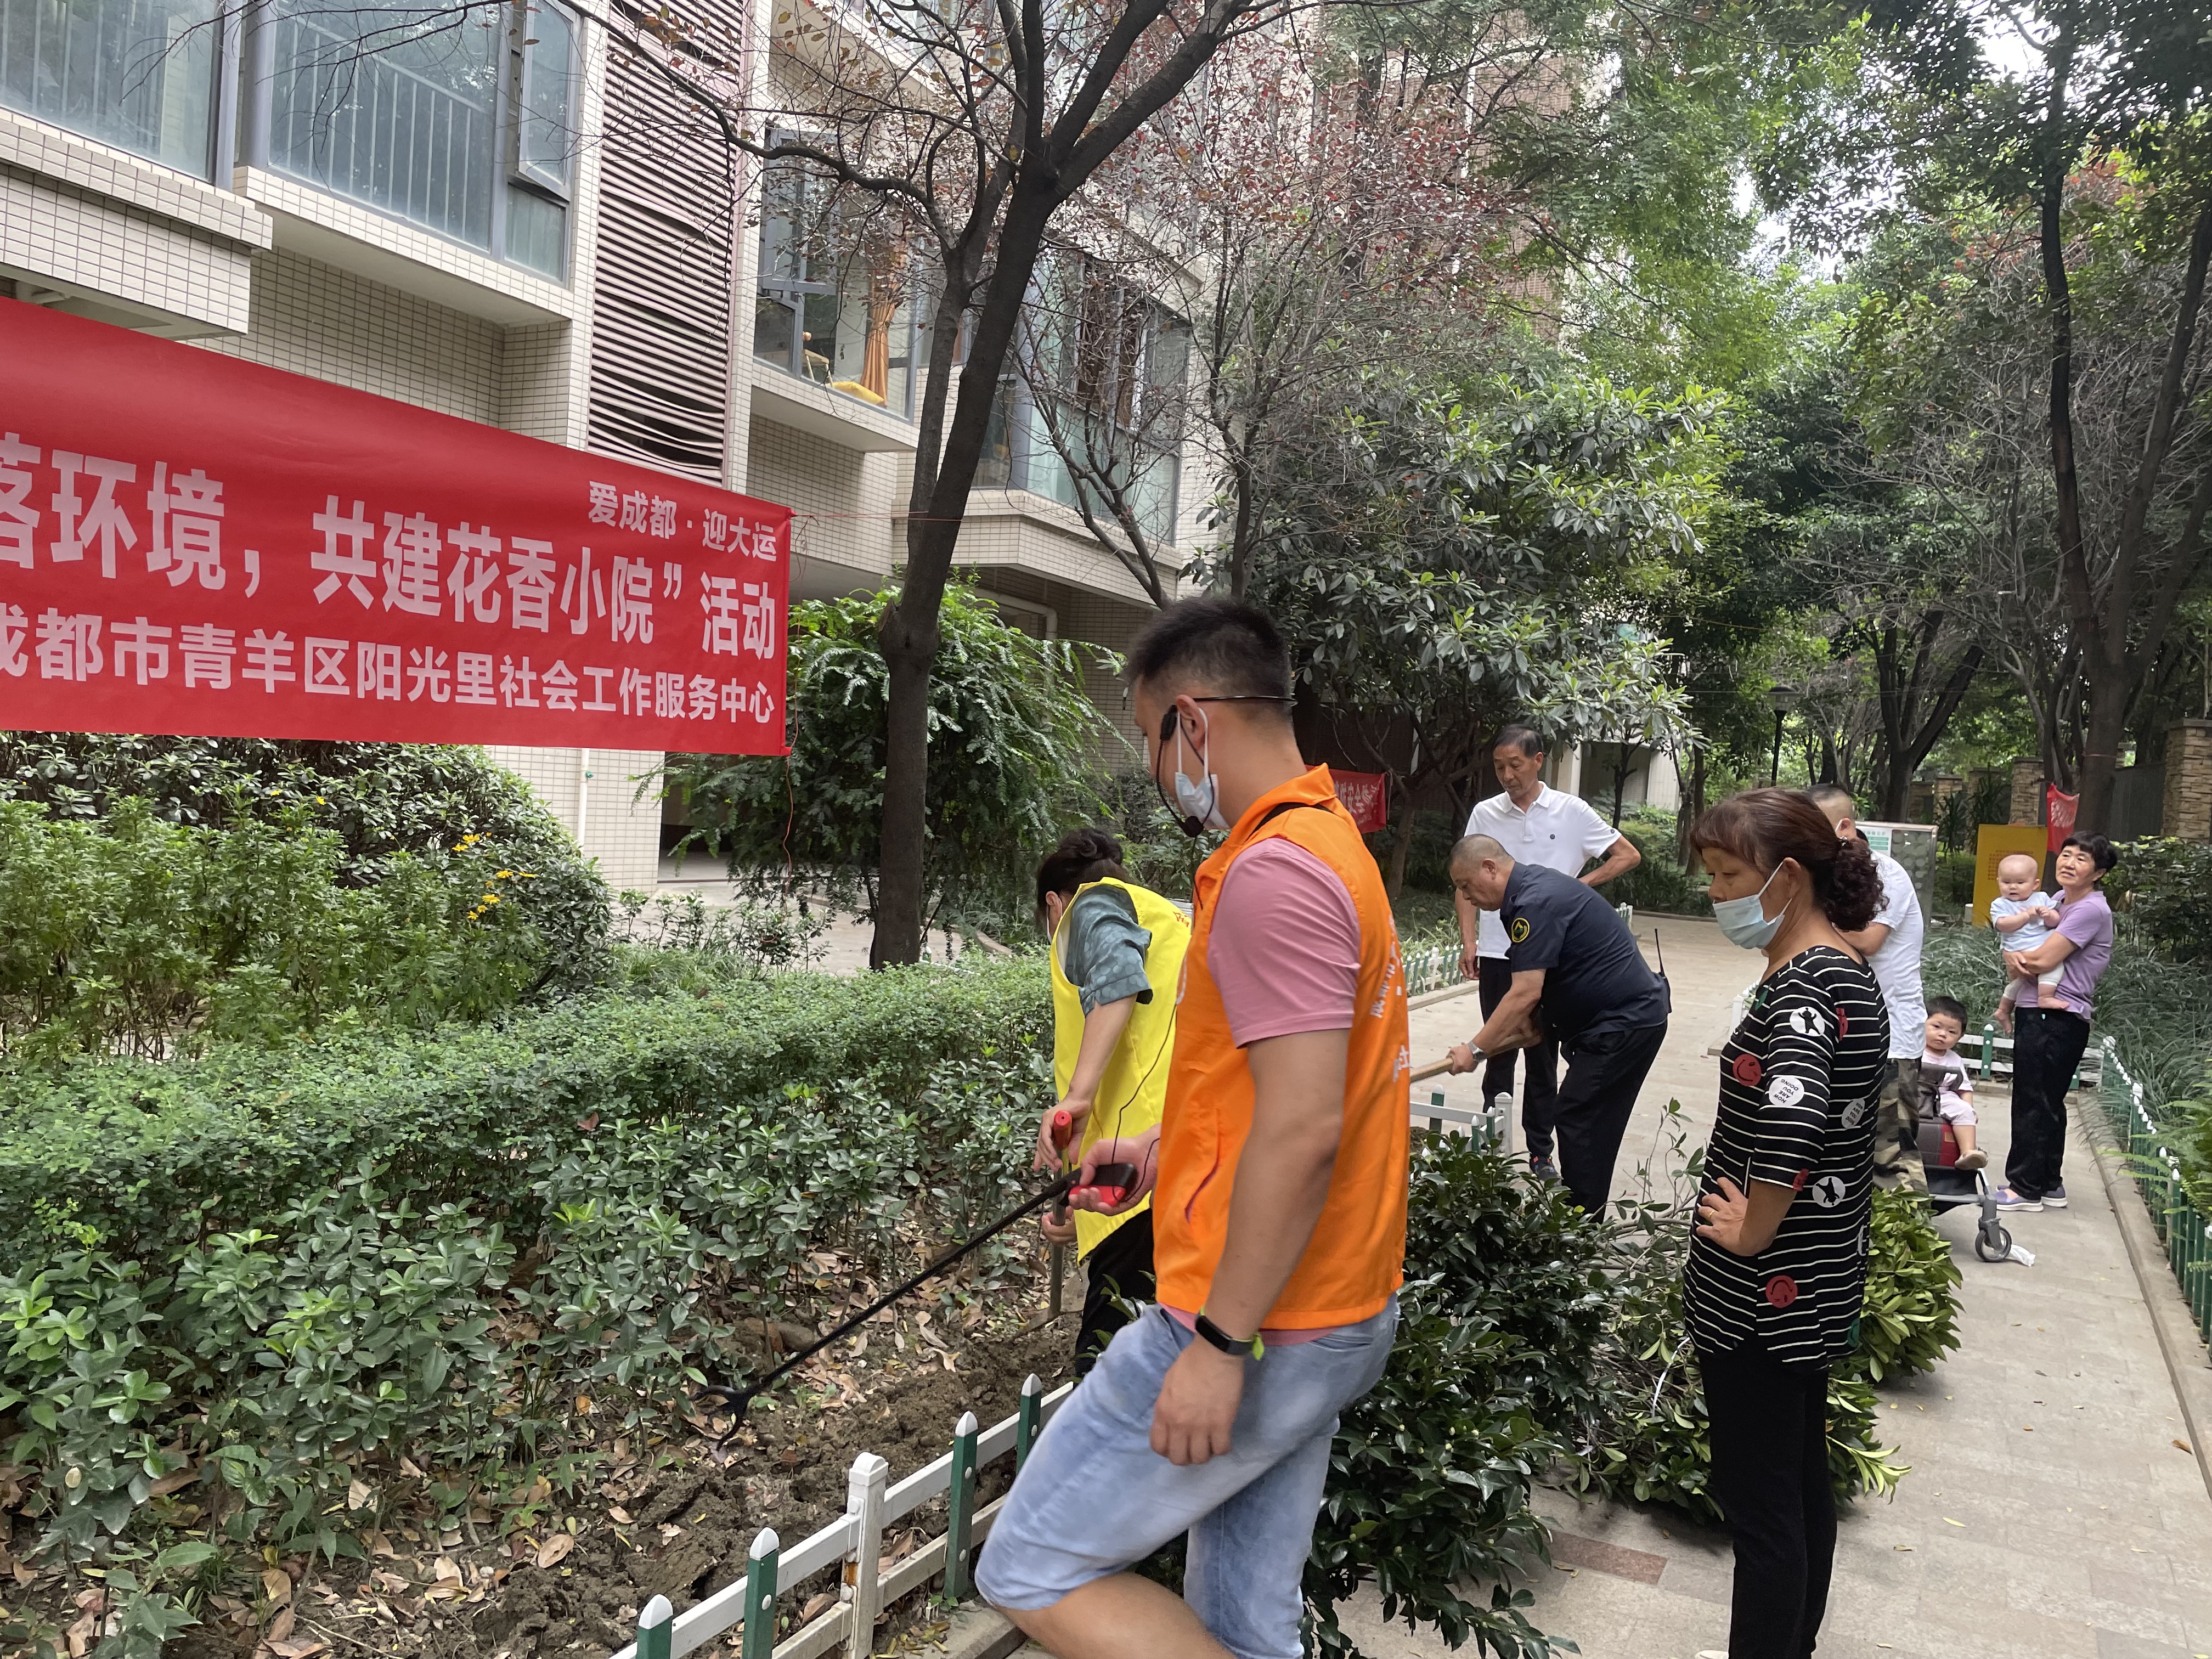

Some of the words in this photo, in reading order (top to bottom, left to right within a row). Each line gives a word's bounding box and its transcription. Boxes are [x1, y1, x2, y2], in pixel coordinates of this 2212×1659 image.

[589, 481, 777, 562] 爱成都·迎大运
[1781, 1079, 1799, 1091] DOING
[1779, 1090, 1791, 1098] ARE
[1782, 1087, 1794, 1095] YOU
[1774, 1094, 1787, 1103] HOW
